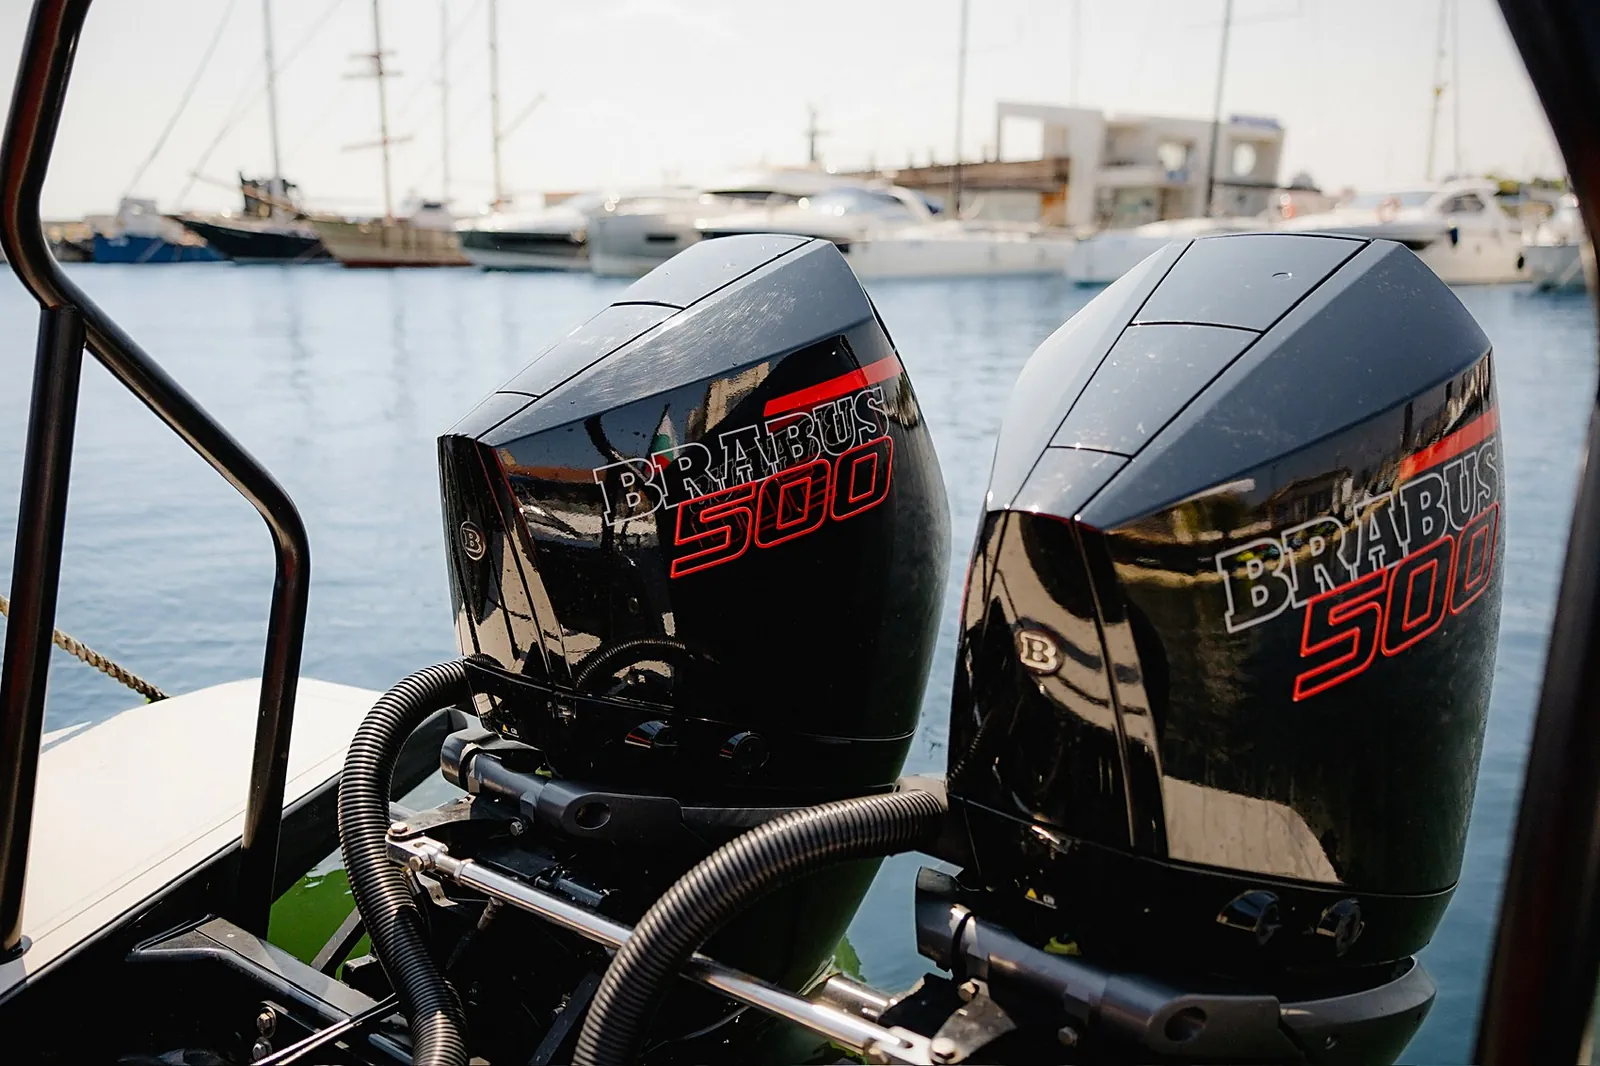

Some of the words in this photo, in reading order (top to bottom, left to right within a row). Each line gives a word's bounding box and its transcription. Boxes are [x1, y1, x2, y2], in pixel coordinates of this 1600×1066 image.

[593, 387, 890, 526] BRABUS
[670, 436, 893, 578] 500
[461, 527, 483, 554] B
[1215, 437, 1499, 634] BRABUS
[1293, 501, 1500, 702] 500
[1019, 630, 1058, 671] B
